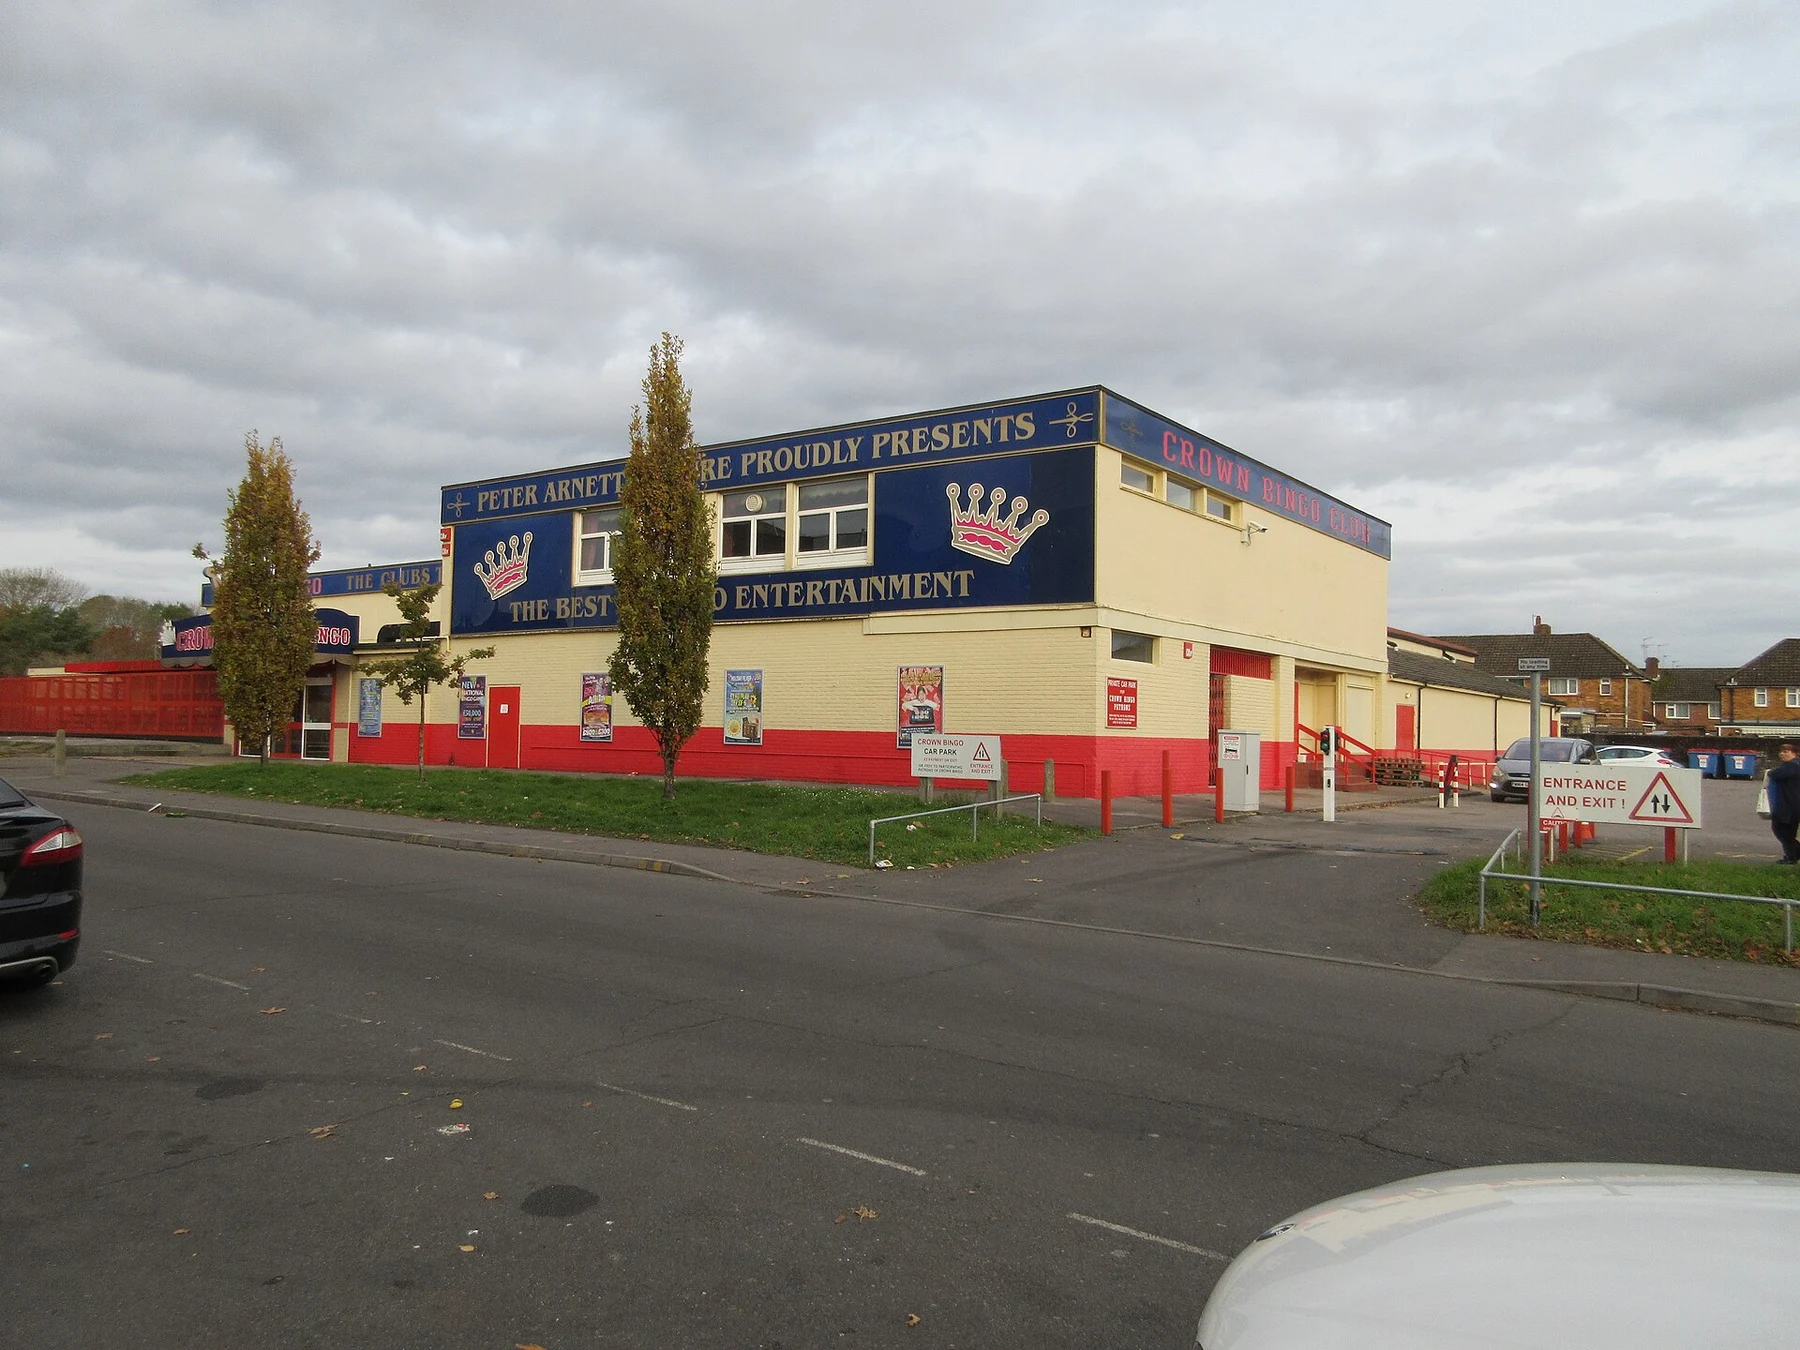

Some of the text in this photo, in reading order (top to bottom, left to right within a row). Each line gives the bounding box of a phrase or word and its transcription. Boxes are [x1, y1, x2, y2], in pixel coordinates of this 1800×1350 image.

[477, 484, 538, 512] PETER
[543, 472, 626, 503] ARNETT
[741, 436, 864, 477] PROUDLY
[872, 412, 1036, 459] PRESENTS
[1162, 431, 1371, 543] CROWN BINGO CLUB
[346, 573, 374, 590] THE
[381, 567, 431, 588] CLUBS
[734, 569, 975, 610] ENTERTAINMENT
[509, 595, 613, 622] THE BEST
[176, 626, 351, 651] CROW NGO
[461, 681, 477, 689] NEW
[918, 738, 964, 747] CROWN BINGO
[939, 748, 957, 756] PARK
[1543, 777, 1627, 791] ENTRANCE
[1545, 795, 1577, 806] AND
[1582, 796, 1616, 808] EXIT
